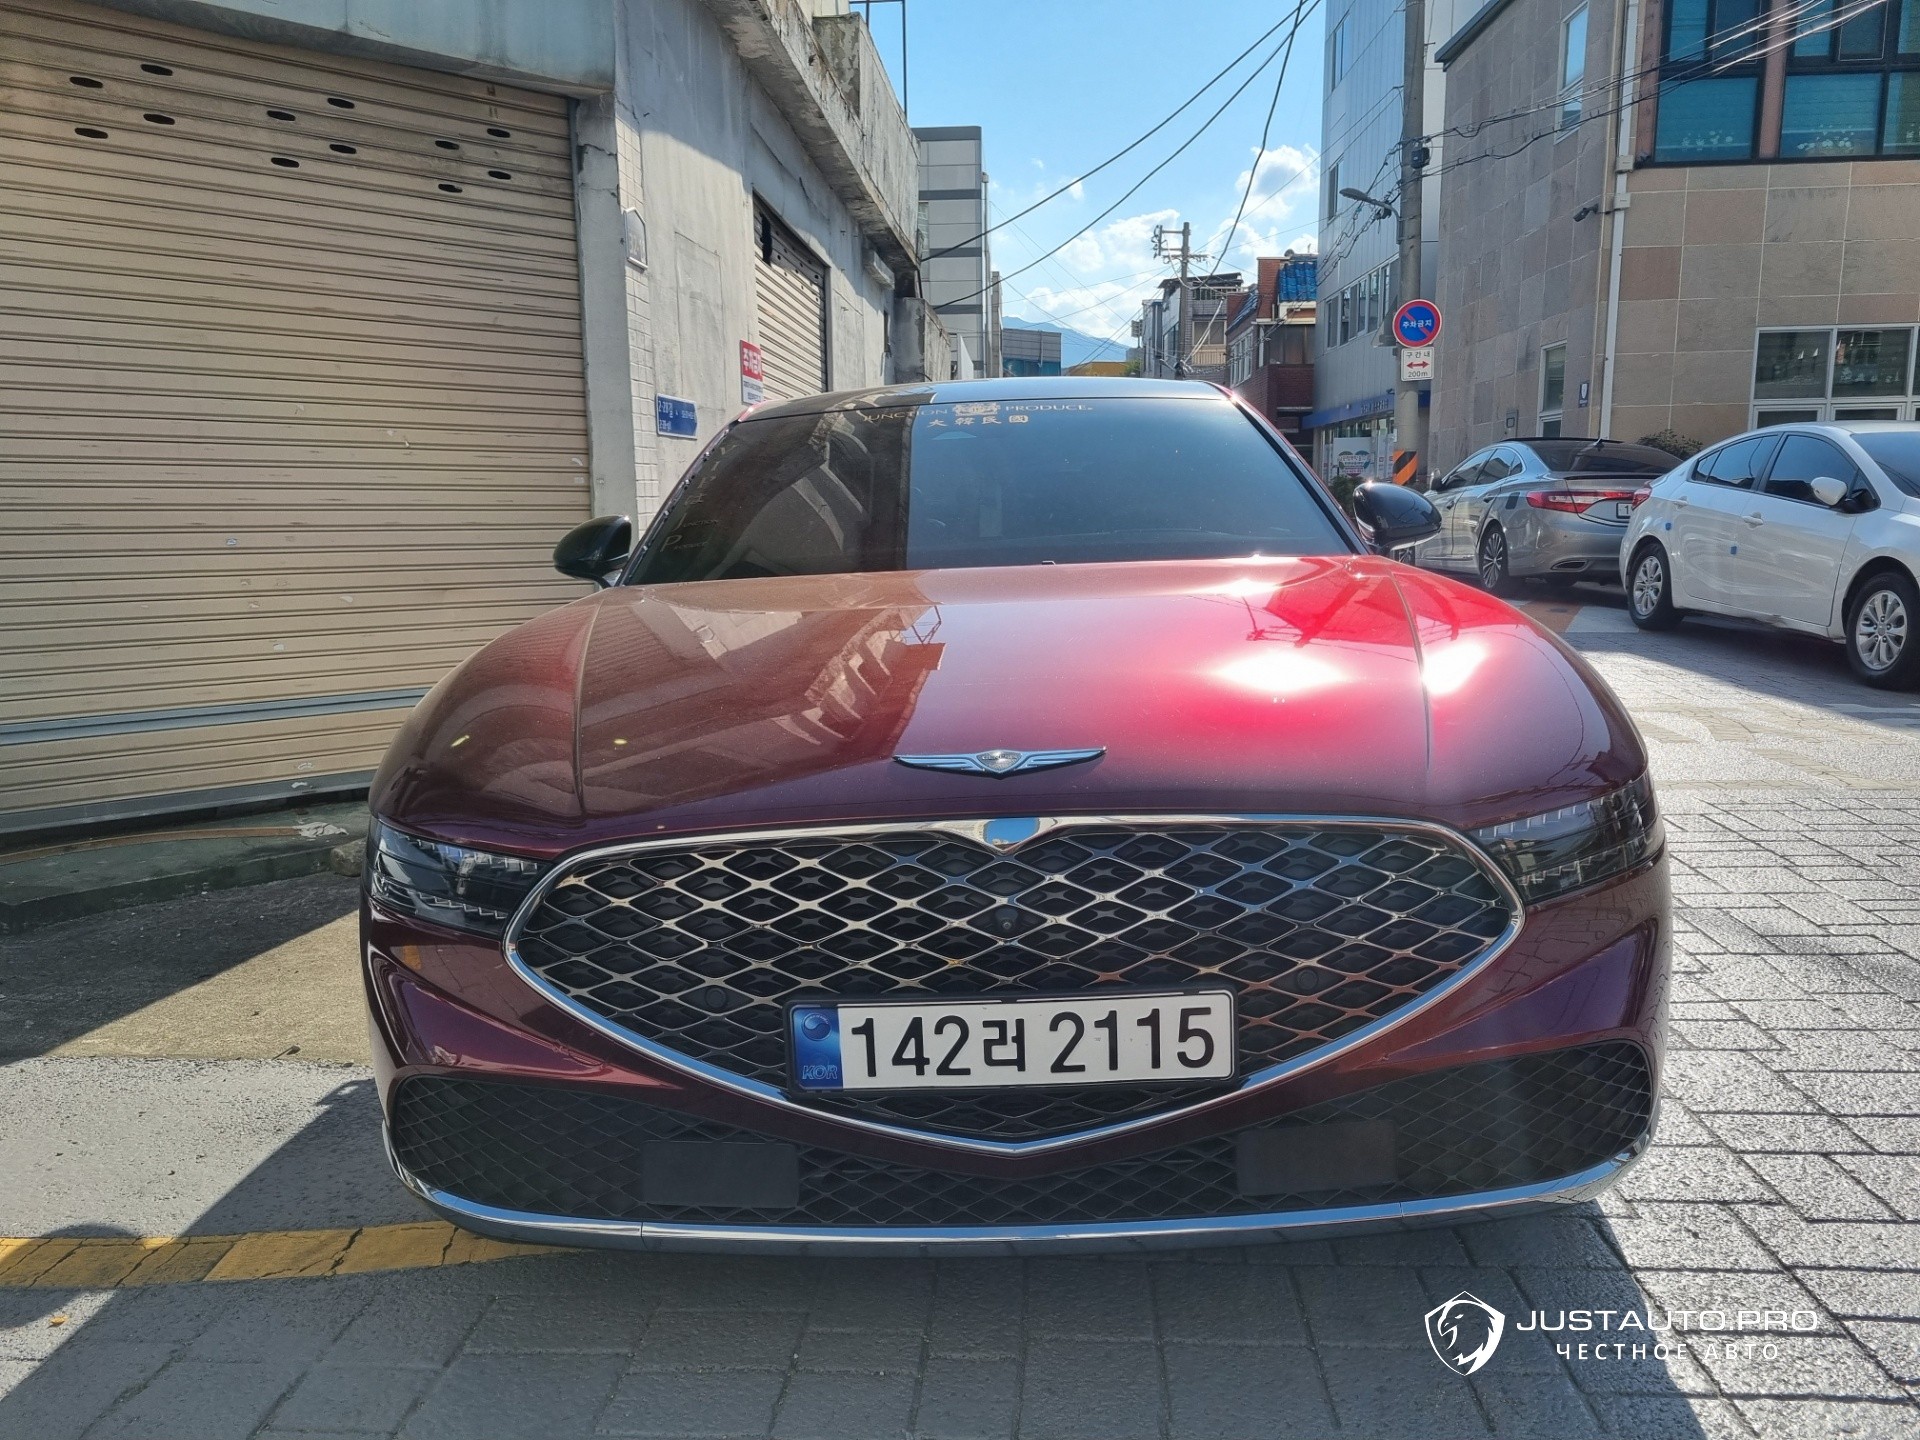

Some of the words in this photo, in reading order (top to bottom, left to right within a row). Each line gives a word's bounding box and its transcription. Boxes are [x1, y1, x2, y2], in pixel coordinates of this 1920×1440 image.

[1403, 319, 1432, 328] 주차금지
[851, 1014, 1025, 1078] 142러
[1049, 1006, 1215, 1074] 2115
[802, 1065, 838, 1080] KOR
